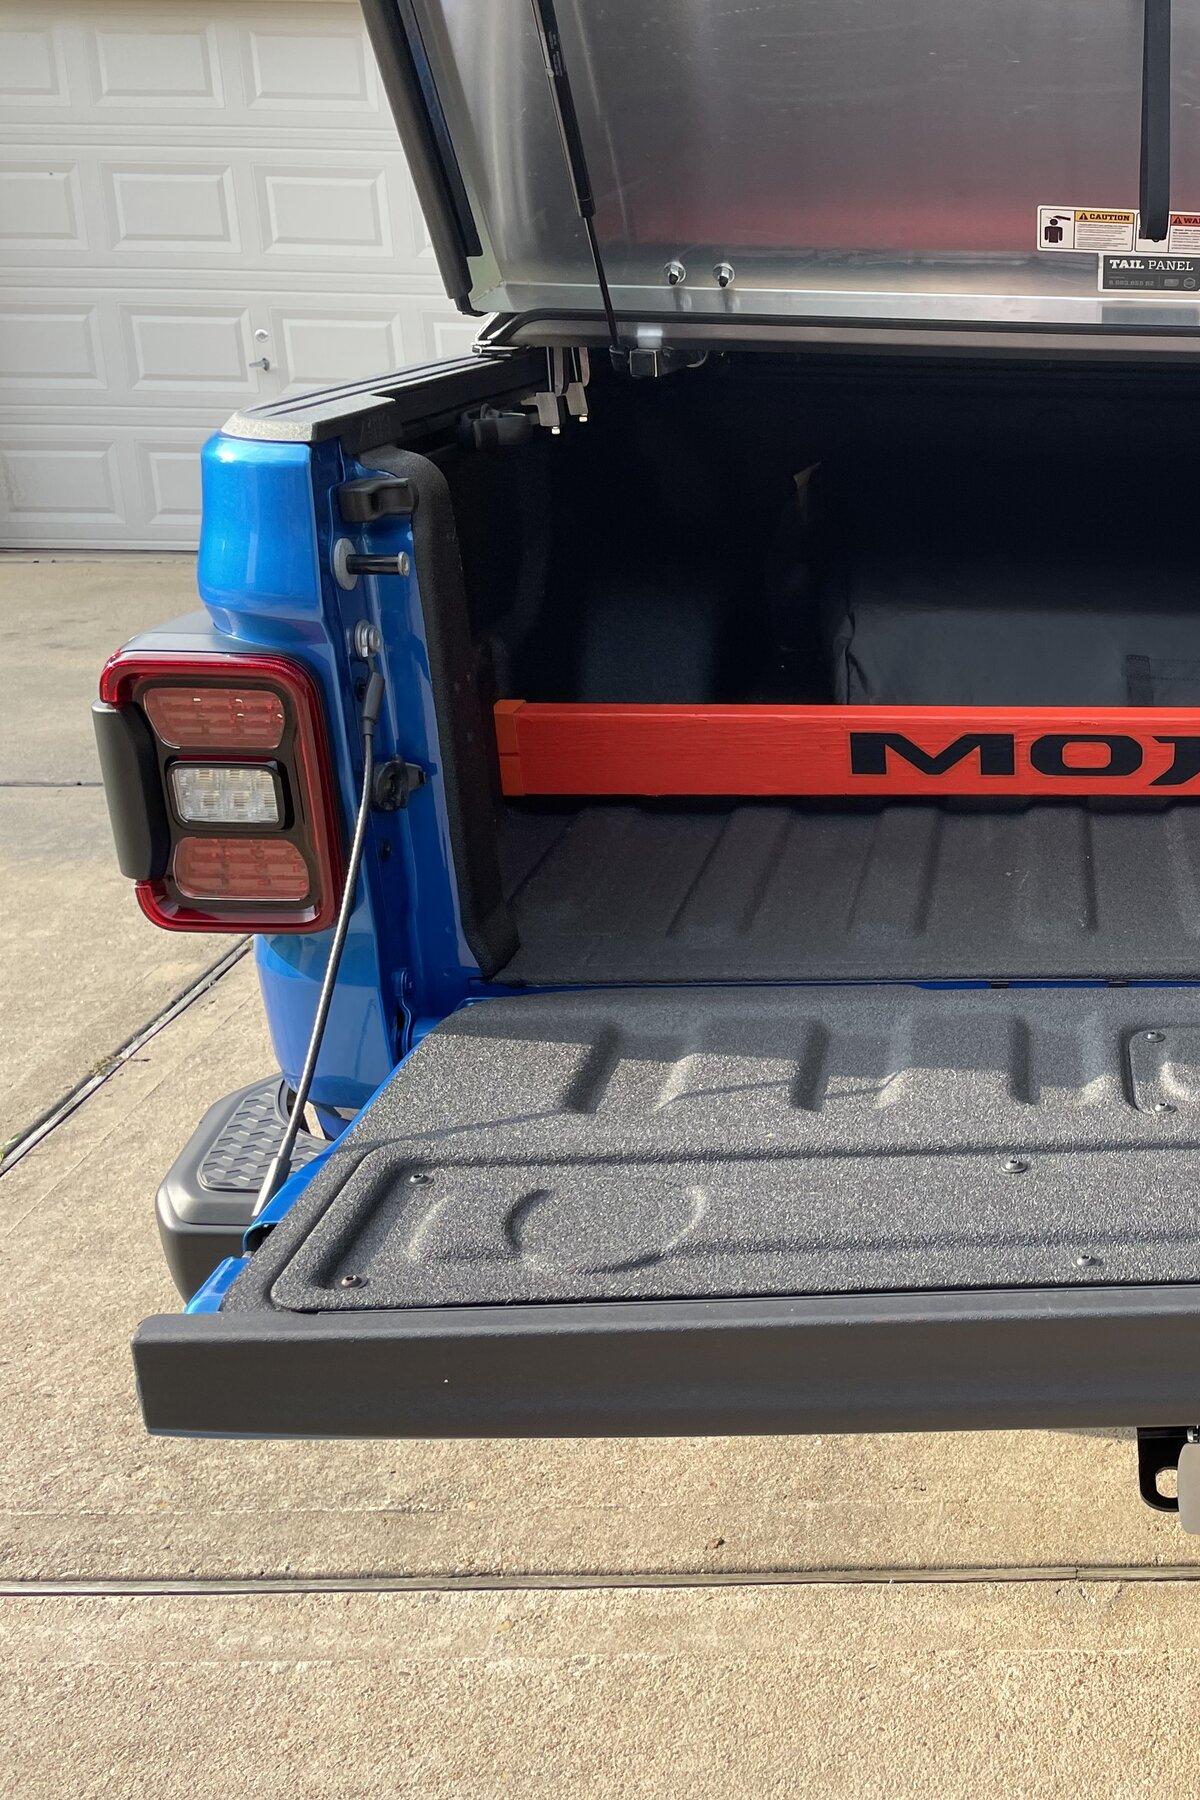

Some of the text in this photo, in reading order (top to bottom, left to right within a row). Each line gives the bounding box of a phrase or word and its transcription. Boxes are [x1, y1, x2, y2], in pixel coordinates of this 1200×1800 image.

[1089, 213, 1130, 221] CAUTION
[1109, 259, 1194, 271] TAIL PANEL
